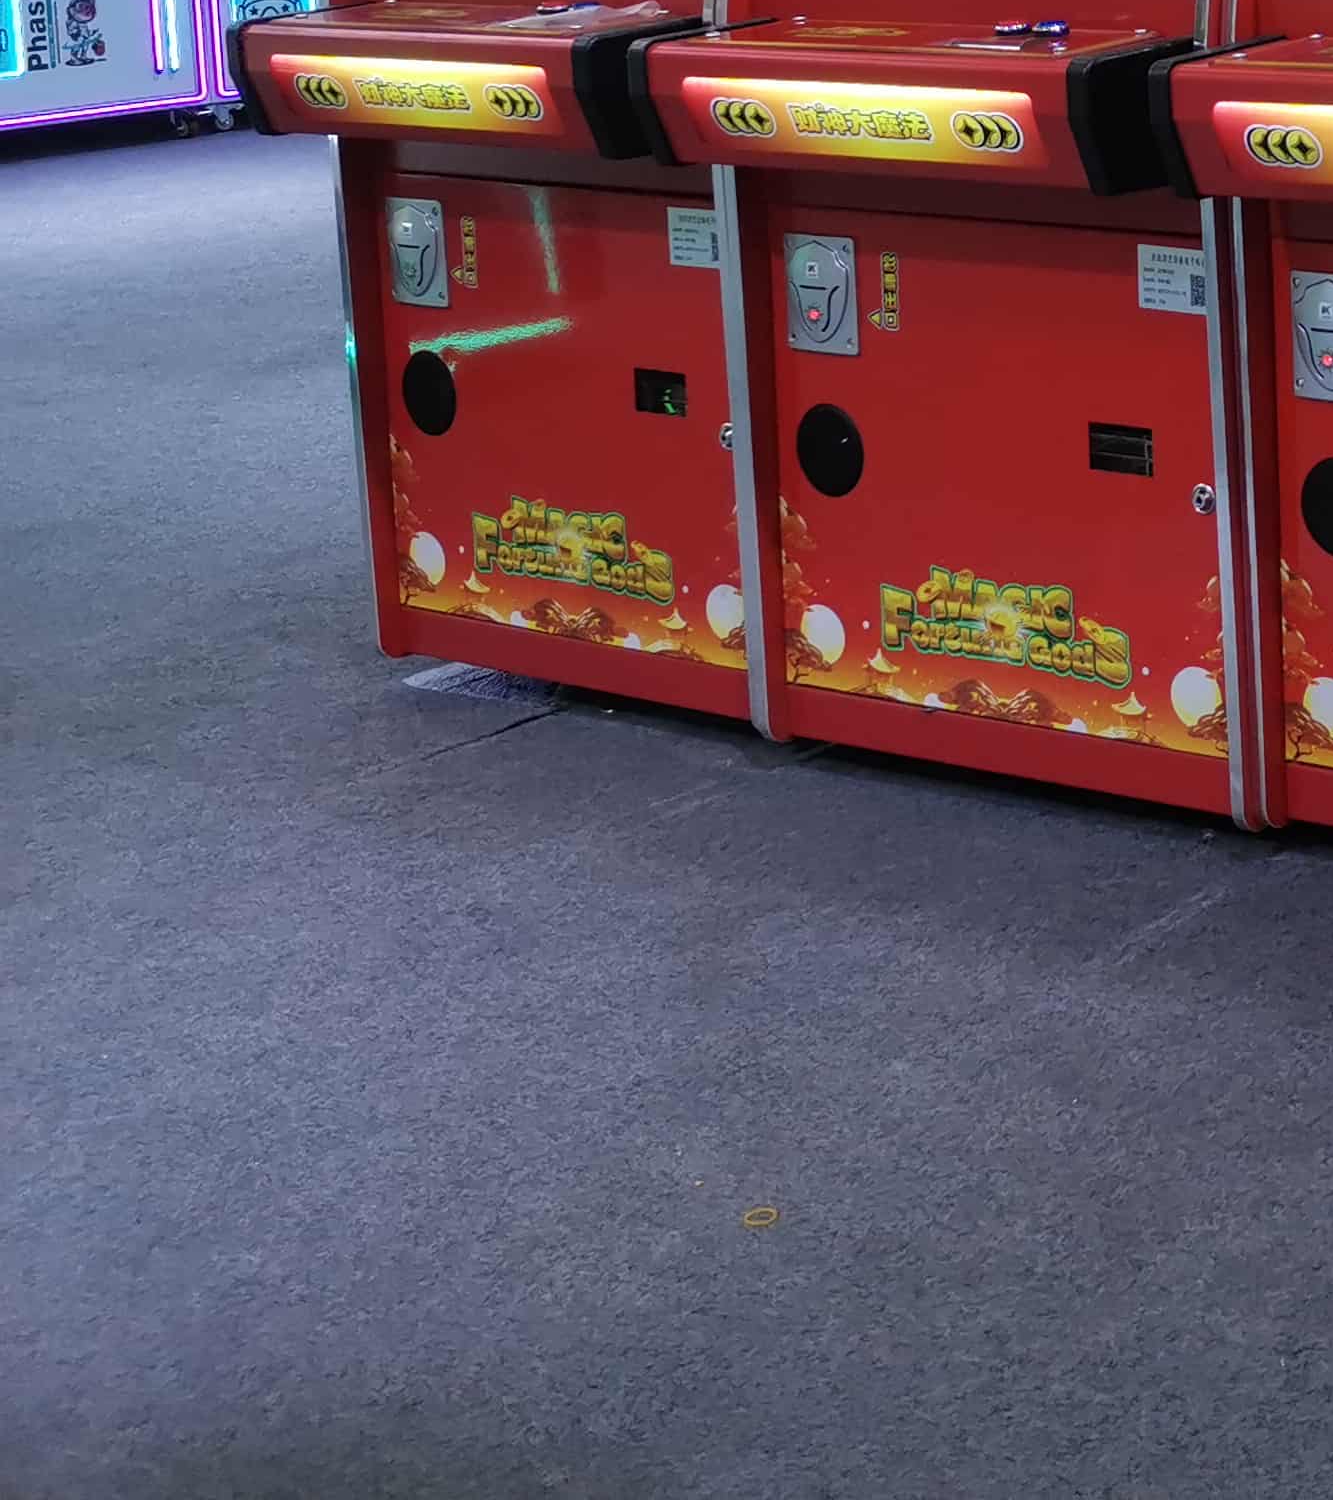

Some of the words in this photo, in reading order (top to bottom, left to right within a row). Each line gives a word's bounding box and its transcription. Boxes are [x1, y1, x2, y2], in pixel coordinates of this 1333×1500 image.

[789, 101, 932, 141] 财神大魔法
